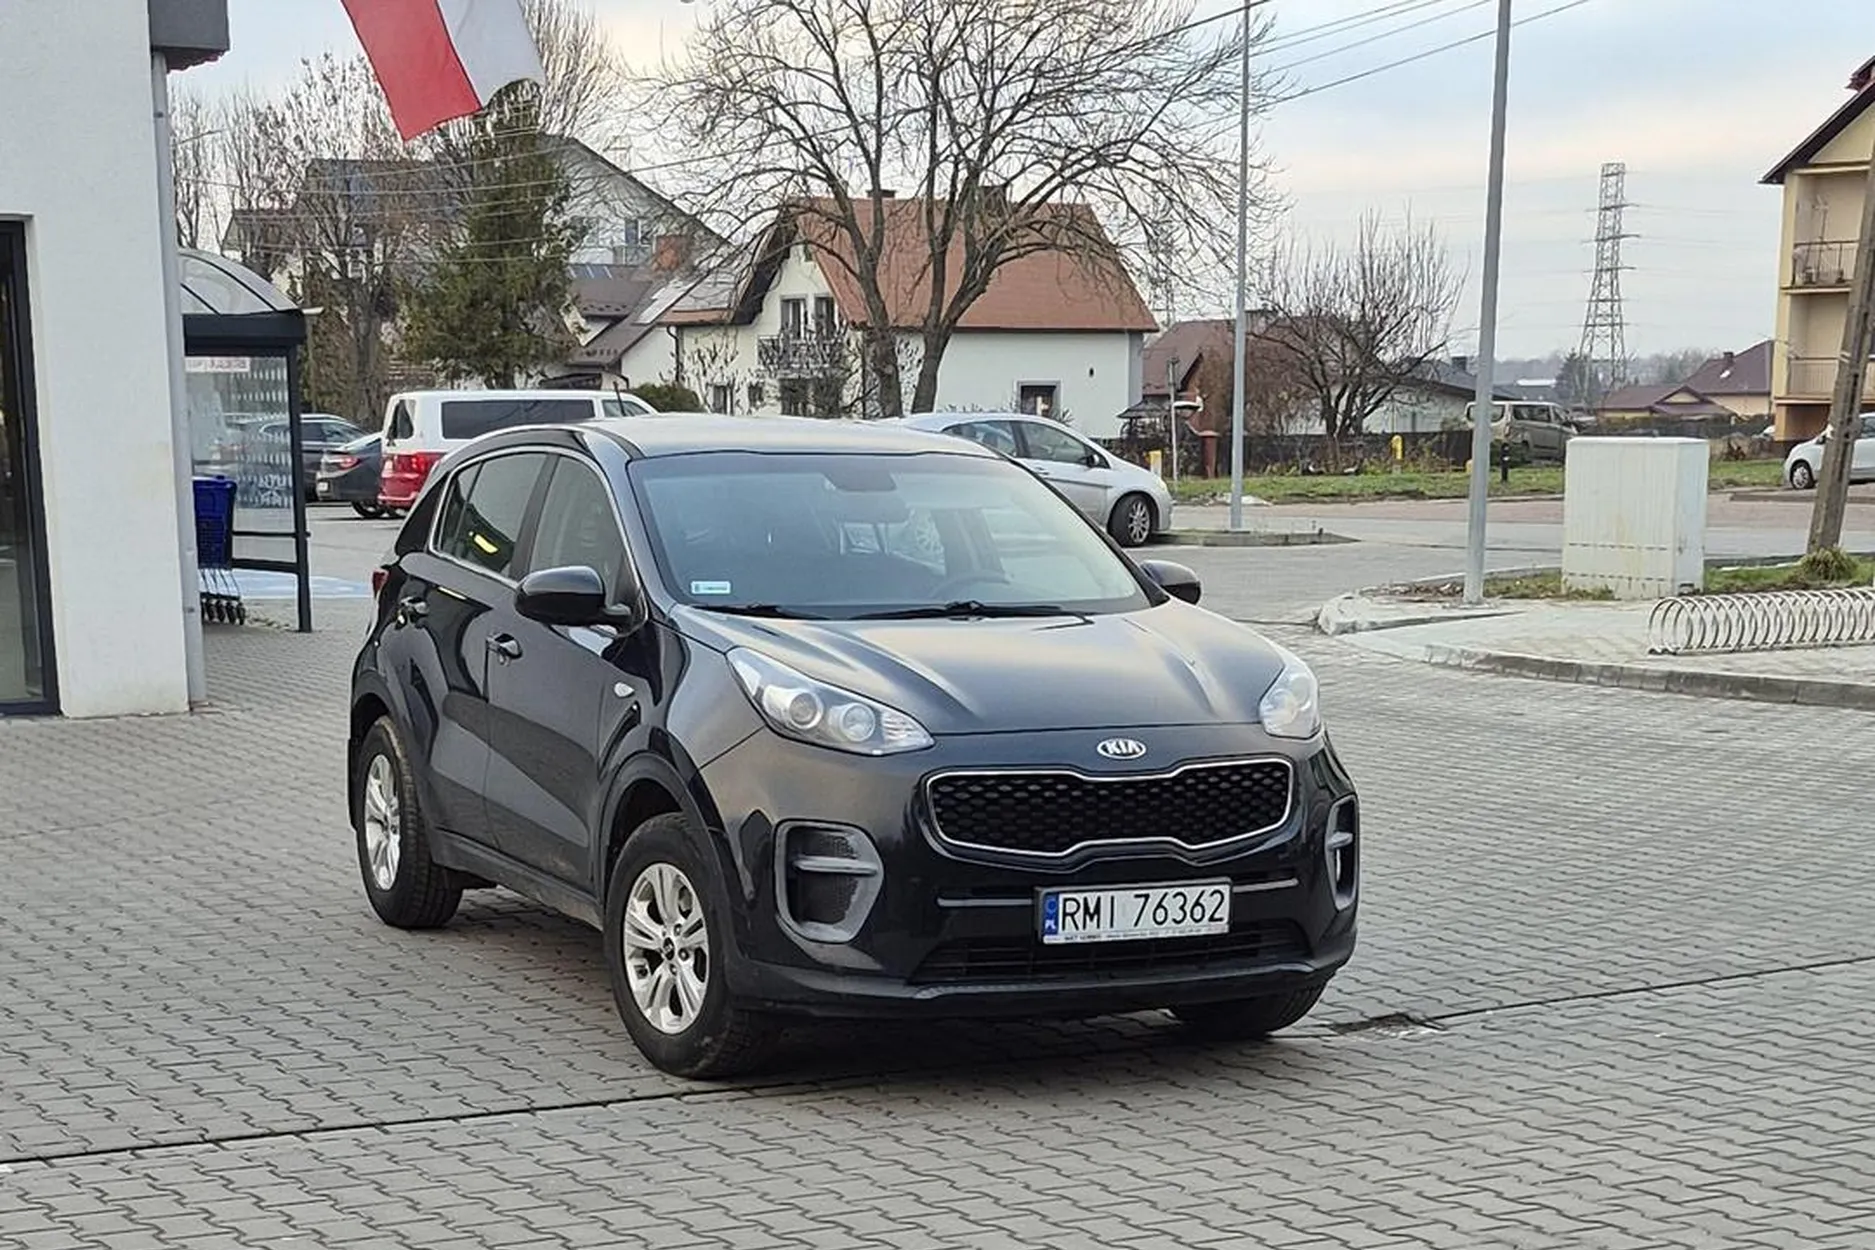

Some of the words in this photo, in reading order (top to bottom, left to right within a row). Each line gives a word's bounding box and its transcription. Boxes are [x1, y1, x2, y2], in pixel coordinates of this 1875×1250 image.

[1104, 739, 1142, 755] KIA
[1061, 895, 1115, 932] RMI
[1133, 889, 1226, 928] 76362
